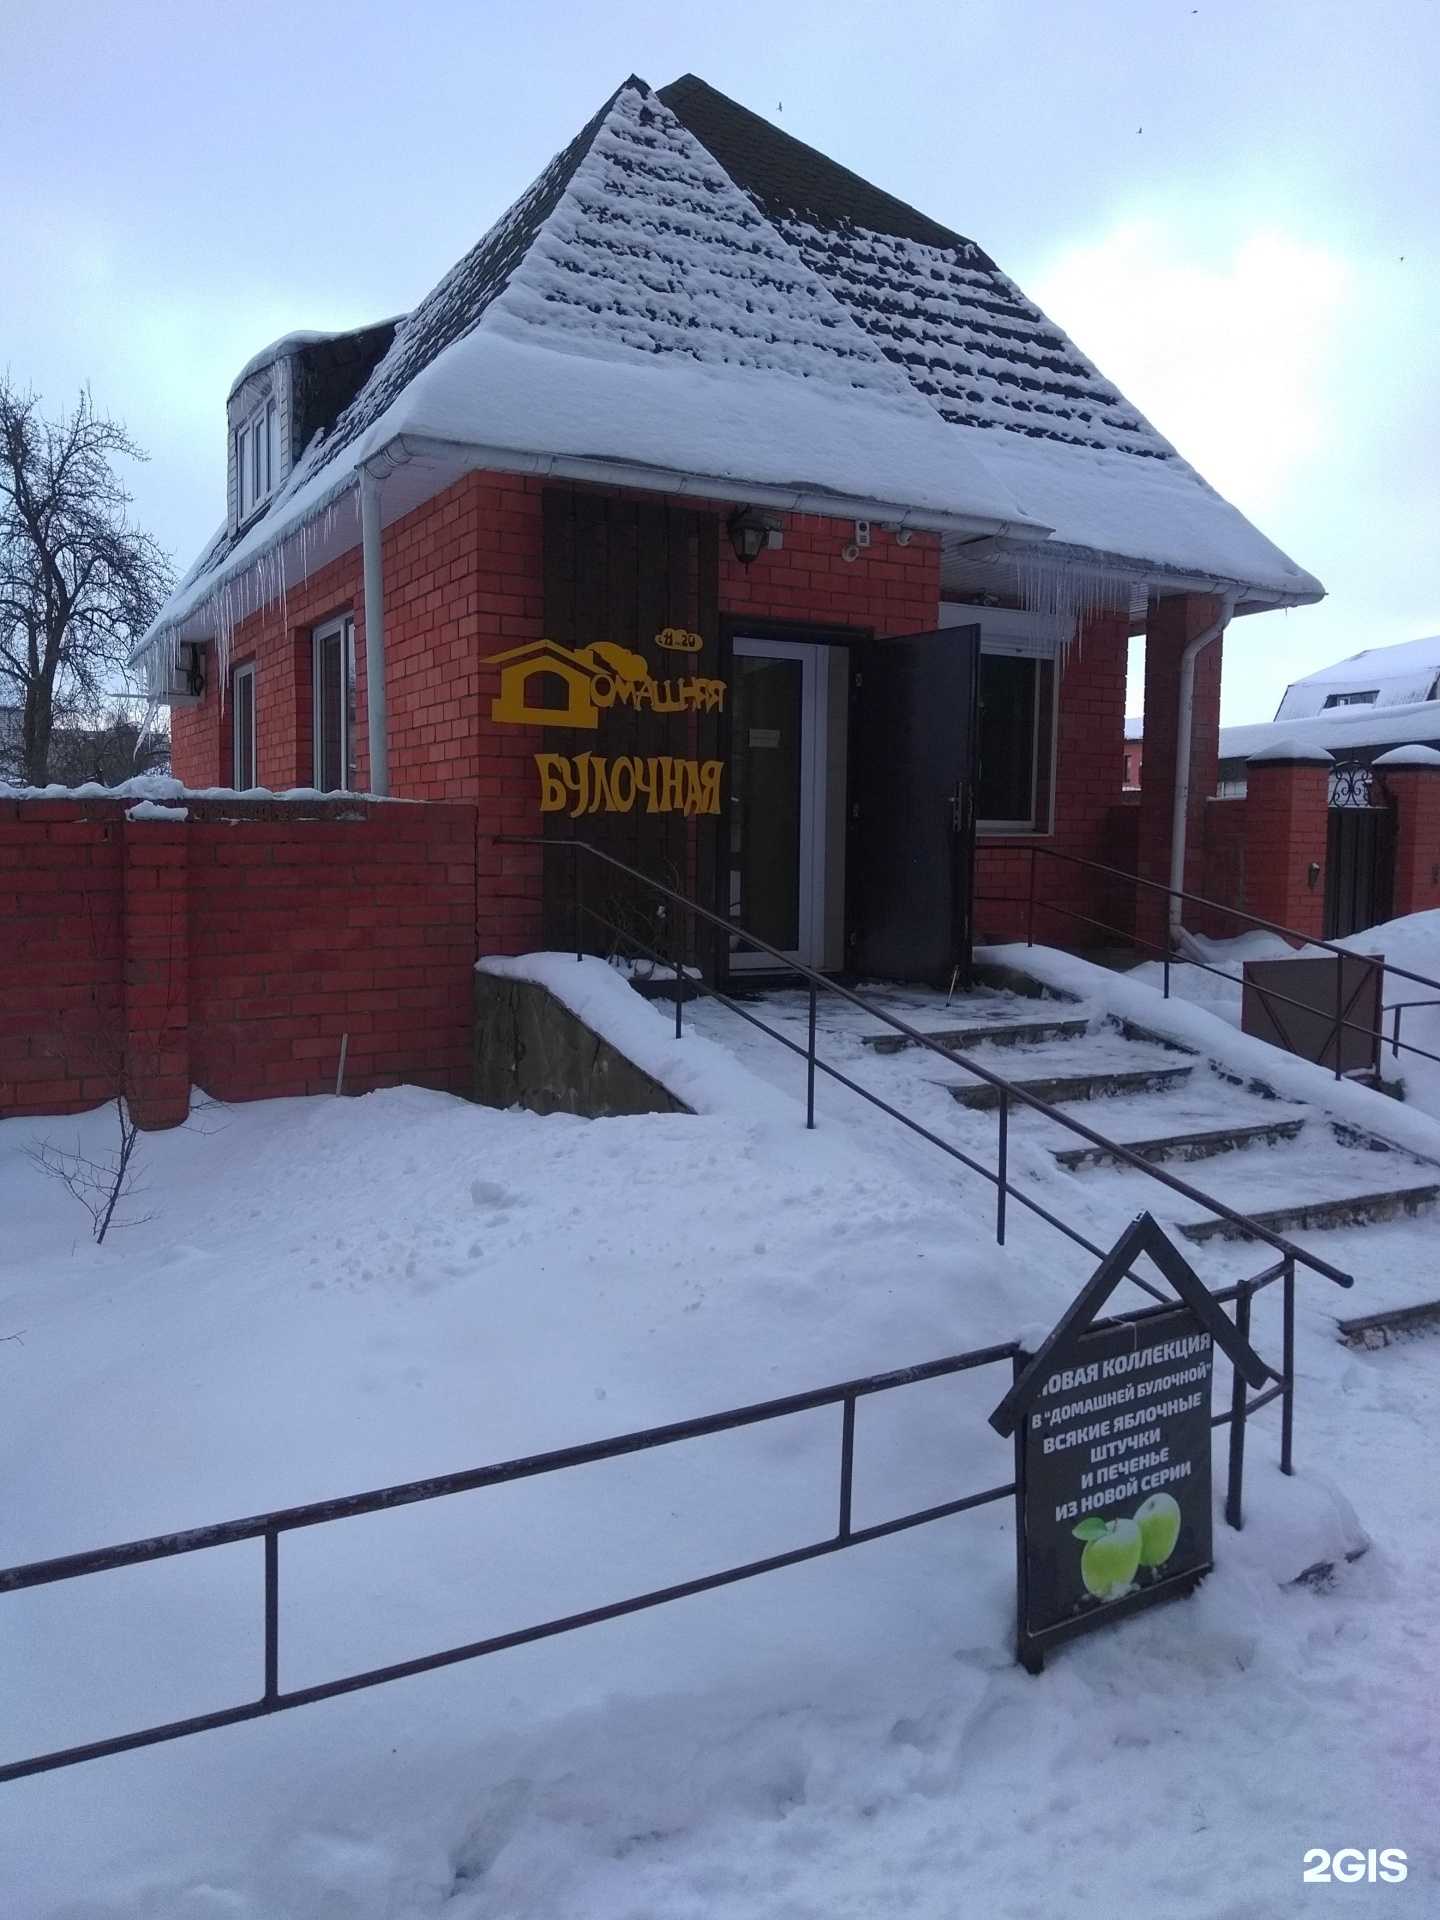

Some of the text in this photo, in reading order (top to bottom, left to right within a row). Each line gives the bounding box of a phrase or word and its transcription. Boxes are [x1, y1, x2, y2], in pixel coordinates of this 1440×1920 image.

[534, 751, 724, 818] БУЛОЧНАЯ
[1102, 1333, 1212, 1379] КОЛЛЕКЦИЯ
[1032, 1414, 1042, 1429] В
[1043, 1391, 1203, 1455] ВСЯКИЕ ЯБЛОЧНЫЕ
[1090, 1427, 1161, 1463] ШТУЧКИ
[1055, 1460, 1192, 1522] ИЗ НОВОЙ СЕРИИ
[1081, 1447, 1170, 1490] И ПЕЧЕНЬЕ
